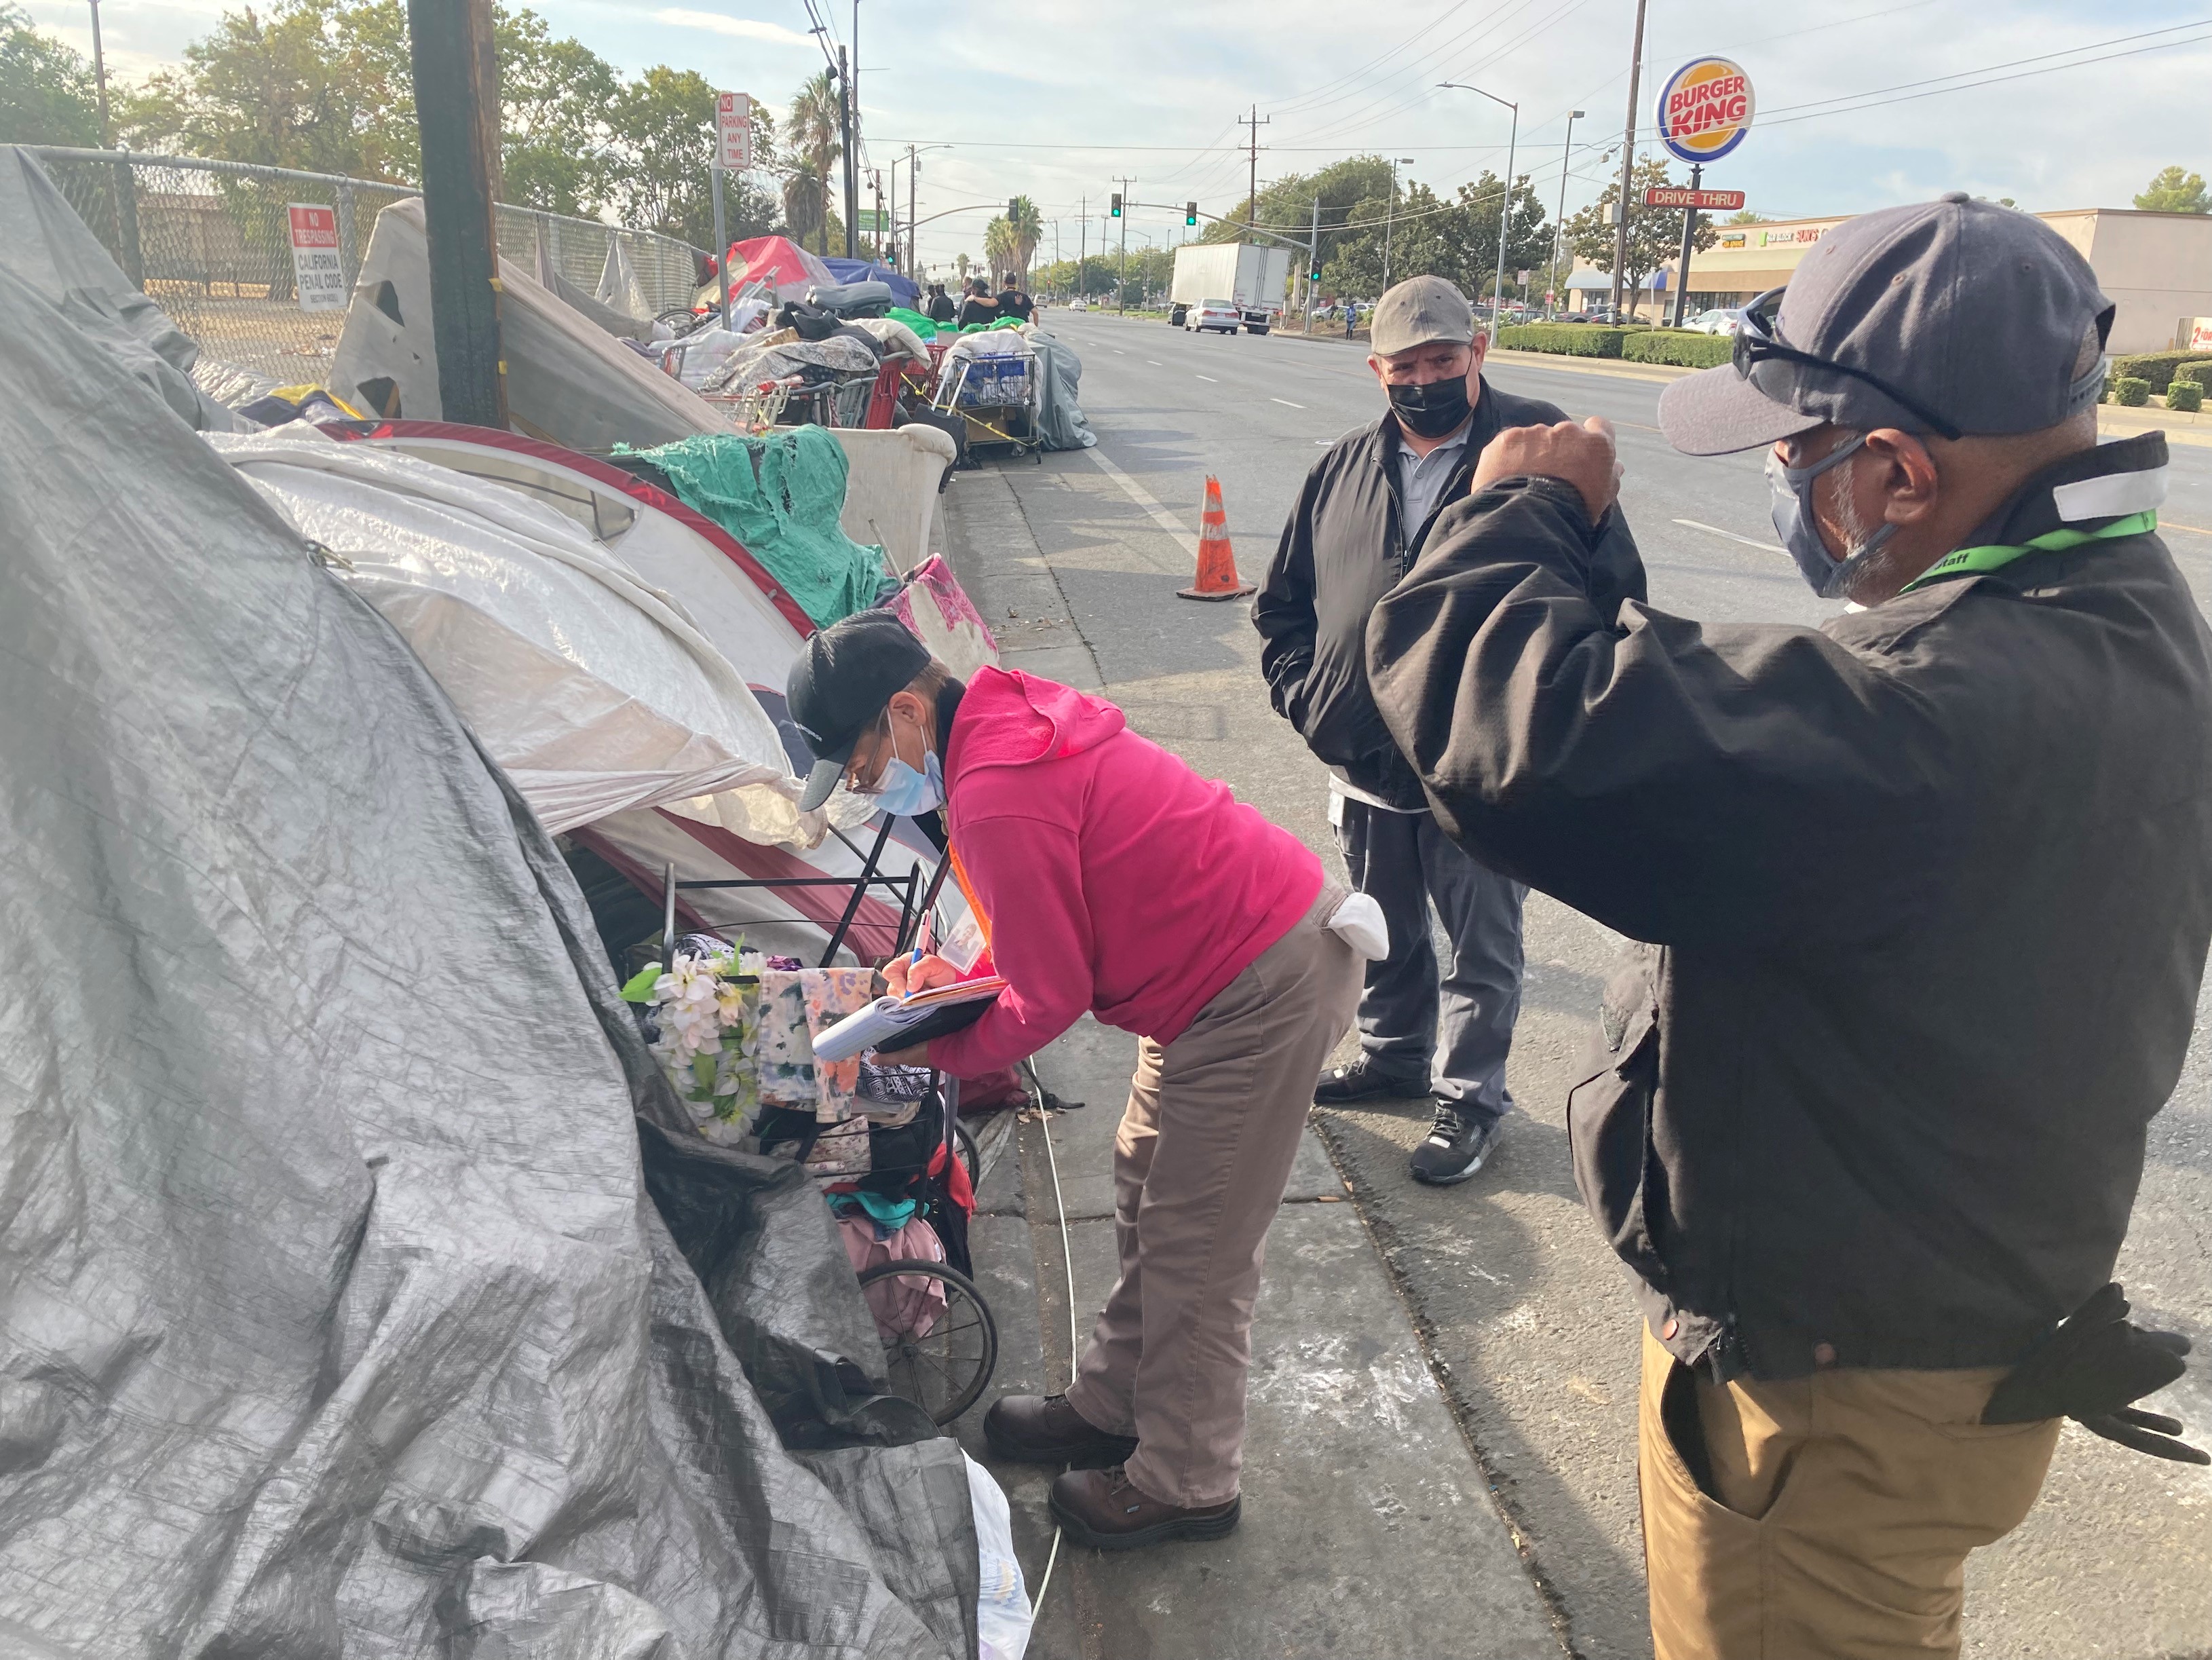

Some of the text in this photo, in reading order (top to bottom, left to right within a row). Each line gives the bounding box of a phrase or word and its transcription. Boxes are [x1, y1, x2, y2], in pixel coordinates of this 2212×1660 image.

[721, 96, 732, 109] NO
[1669, 75, 1745, 115] BURGER
[721, 115, 747, 128] PARKING
[1671, 95, 1747, 141] KING
[727, 132, 742, 143] ANY
[727, 149, 744, 159] TIME
[1654, 191, 1737, 206] DRIVE THRU
[309, 212, 319, 227] NO
[294, 229, 335, 245] TRESPASSING
[299, 254, 339, 270] CALIFORNIA
[299, 273, 343, 290] PENAL CODE
[310, 294, 326, 303] SECTION
[2193, 326, 2201, 343] 2
